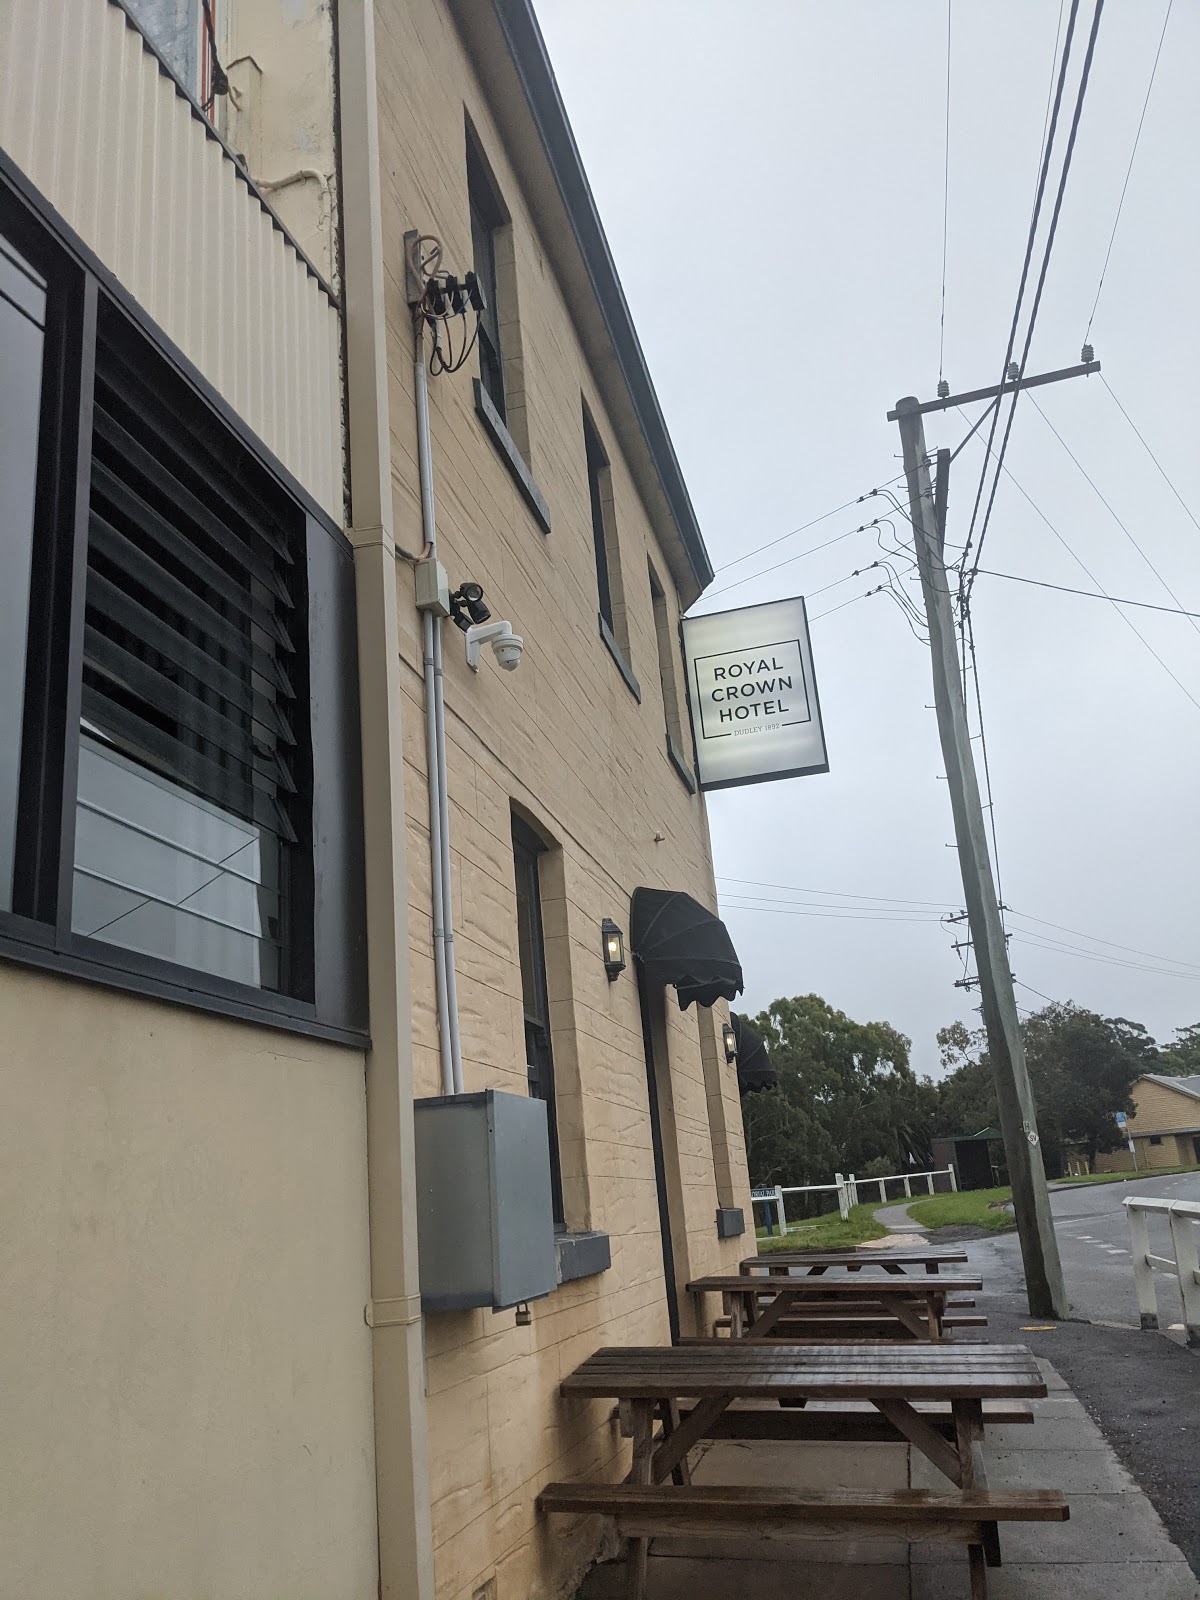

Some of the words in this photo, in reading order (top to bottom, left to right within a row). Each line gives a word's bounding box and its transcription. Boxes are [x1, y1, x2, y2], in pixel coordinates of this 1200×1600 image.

[713, 657, 783, 681] ROYAL
[711, 676, 793, 702] CROWN
[719, 699, 789, 723] HOTEL
[734, 725, 763, 737] DUDLEY
[764, 723, 780, 732] 1892
